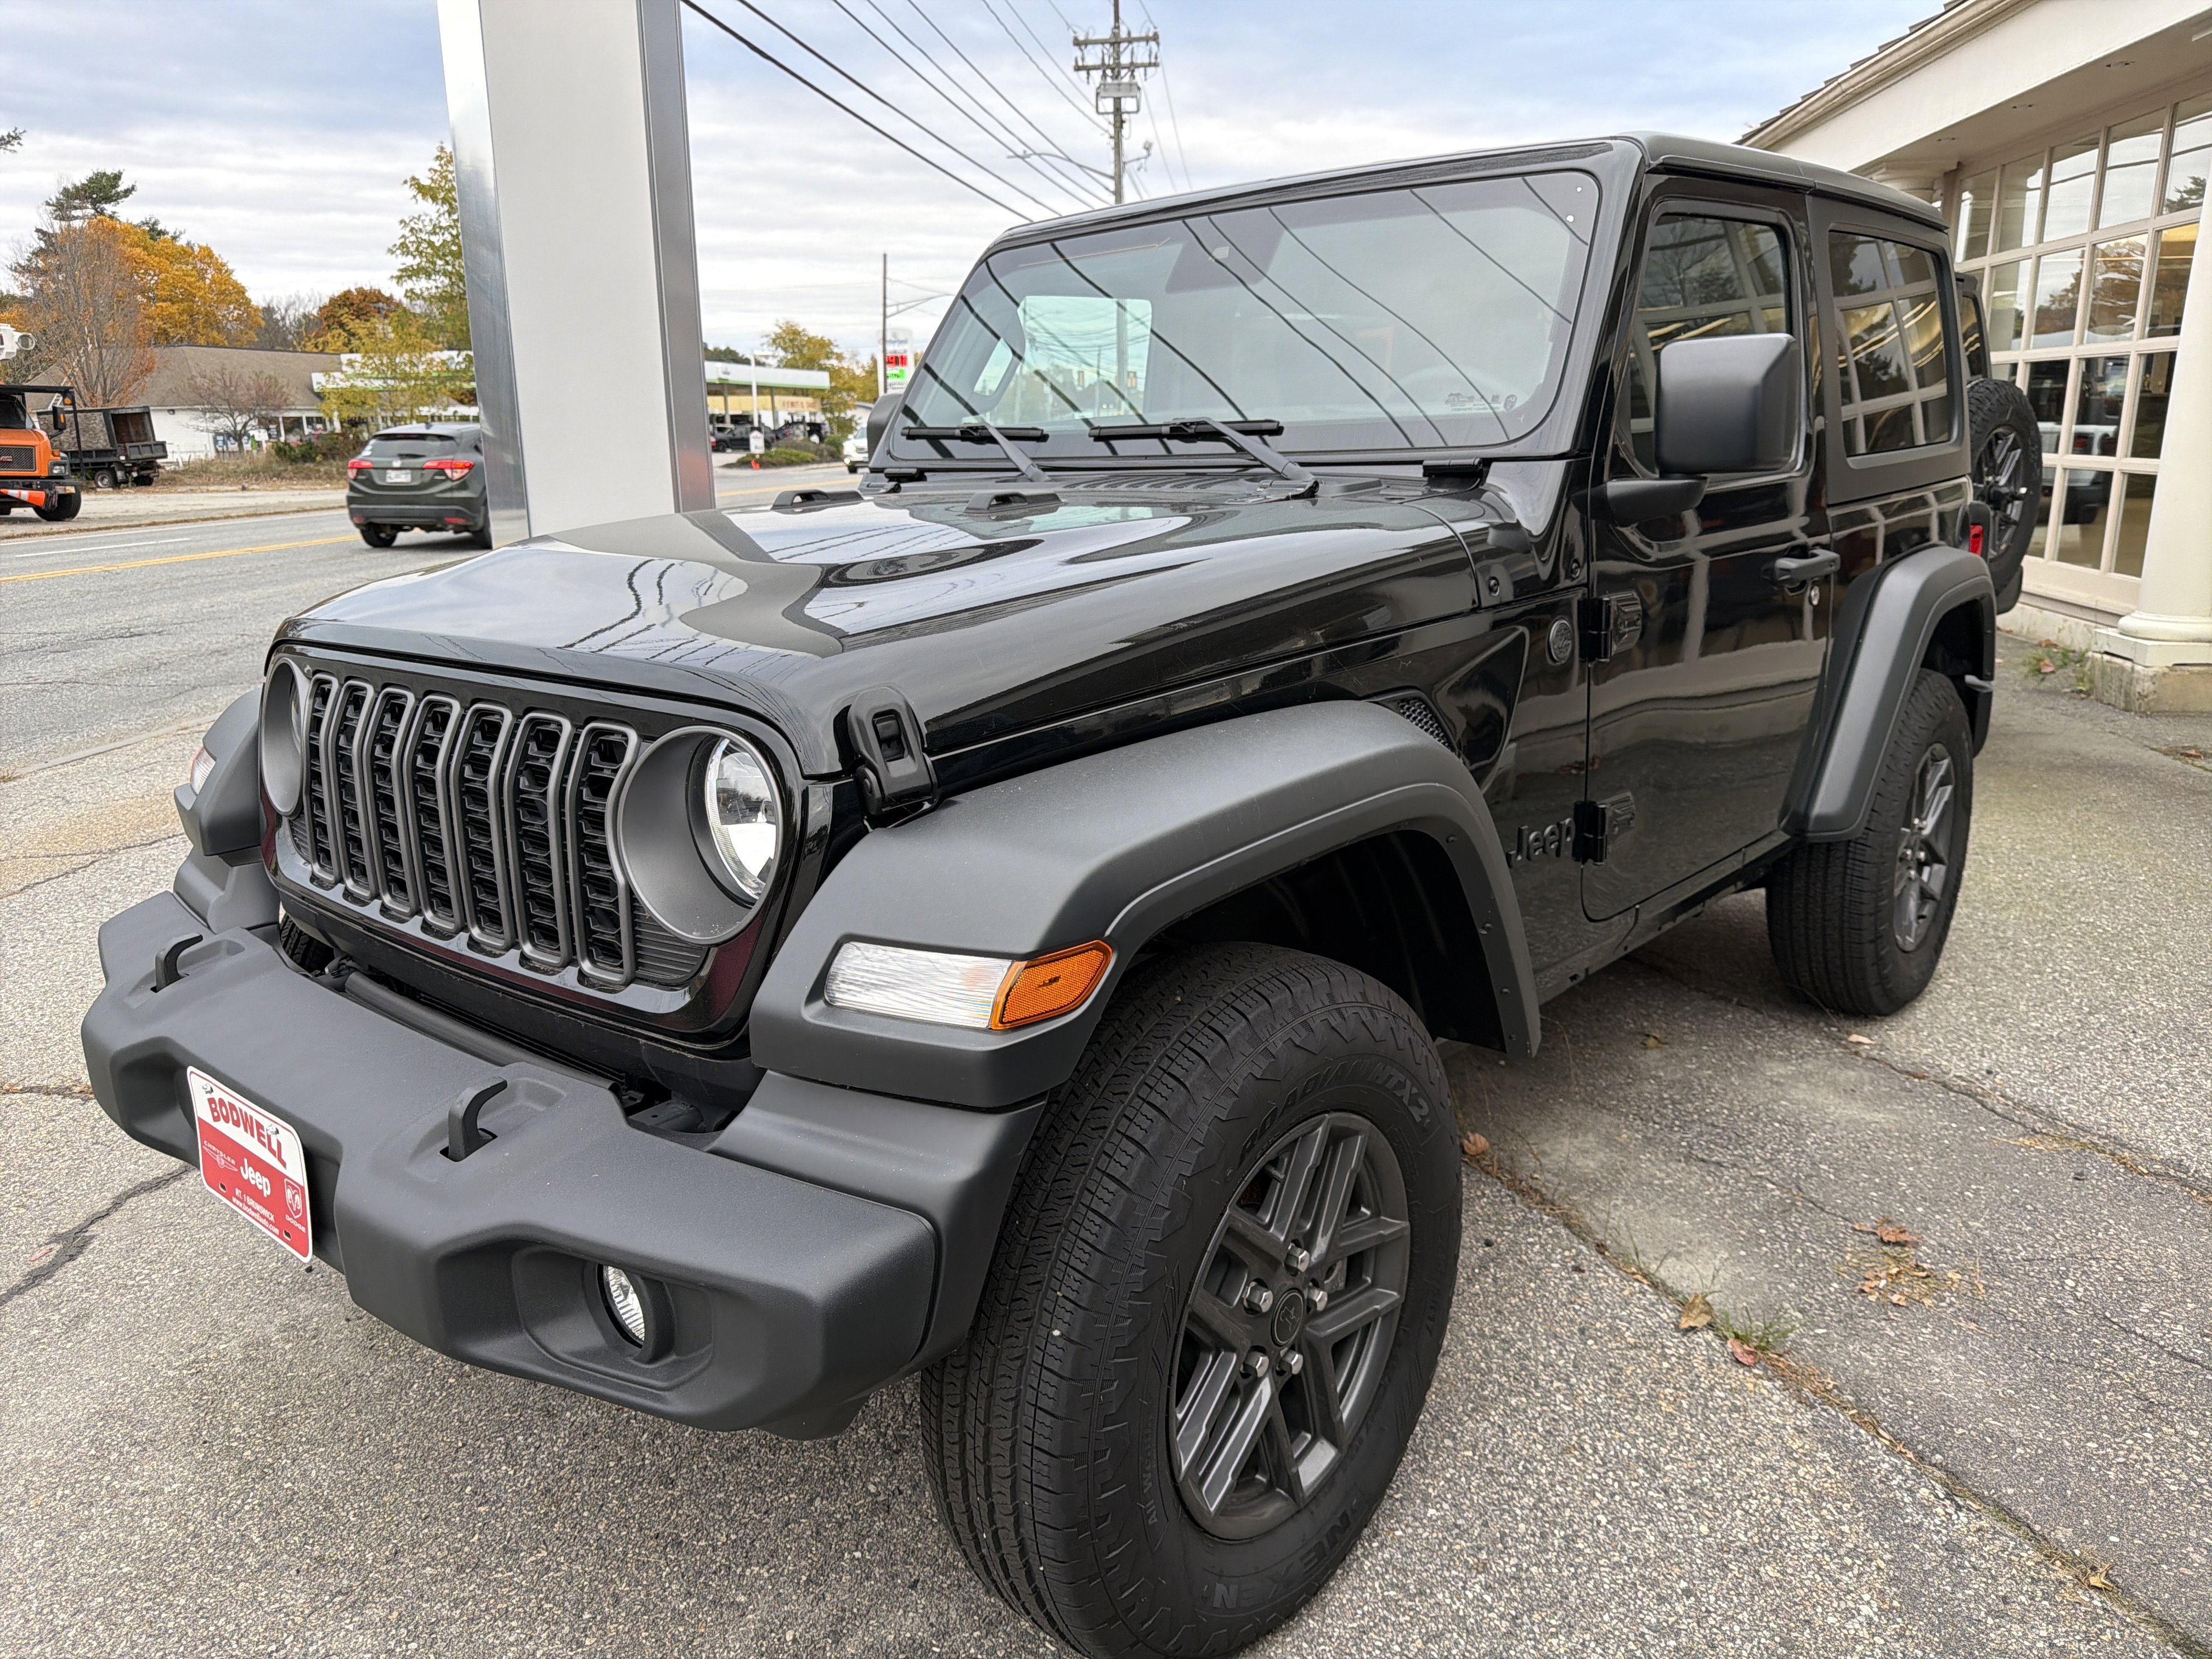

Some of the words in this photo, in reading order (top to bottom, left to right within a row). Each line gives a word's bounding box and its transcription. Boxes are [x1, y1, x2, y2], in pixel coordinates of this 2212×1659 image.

[1505, 817, 1575, 868] Jeep
[1367, 1062, 1429, 1123] HTX2
[204, 1140, 236, 1165] CHRYSLER
[207, 1097, 286, 1170] BODWELL
[240, 1158, 271, 1198] Jeep
[232, 1196, 279, 1235] www.bodwellauto.com
[246, 1195, 275, 1223] BRUNSWICK
[285, 1214, 306, 1233] DODGE
[1212, 1509, 1351, 1609] NEXEN
